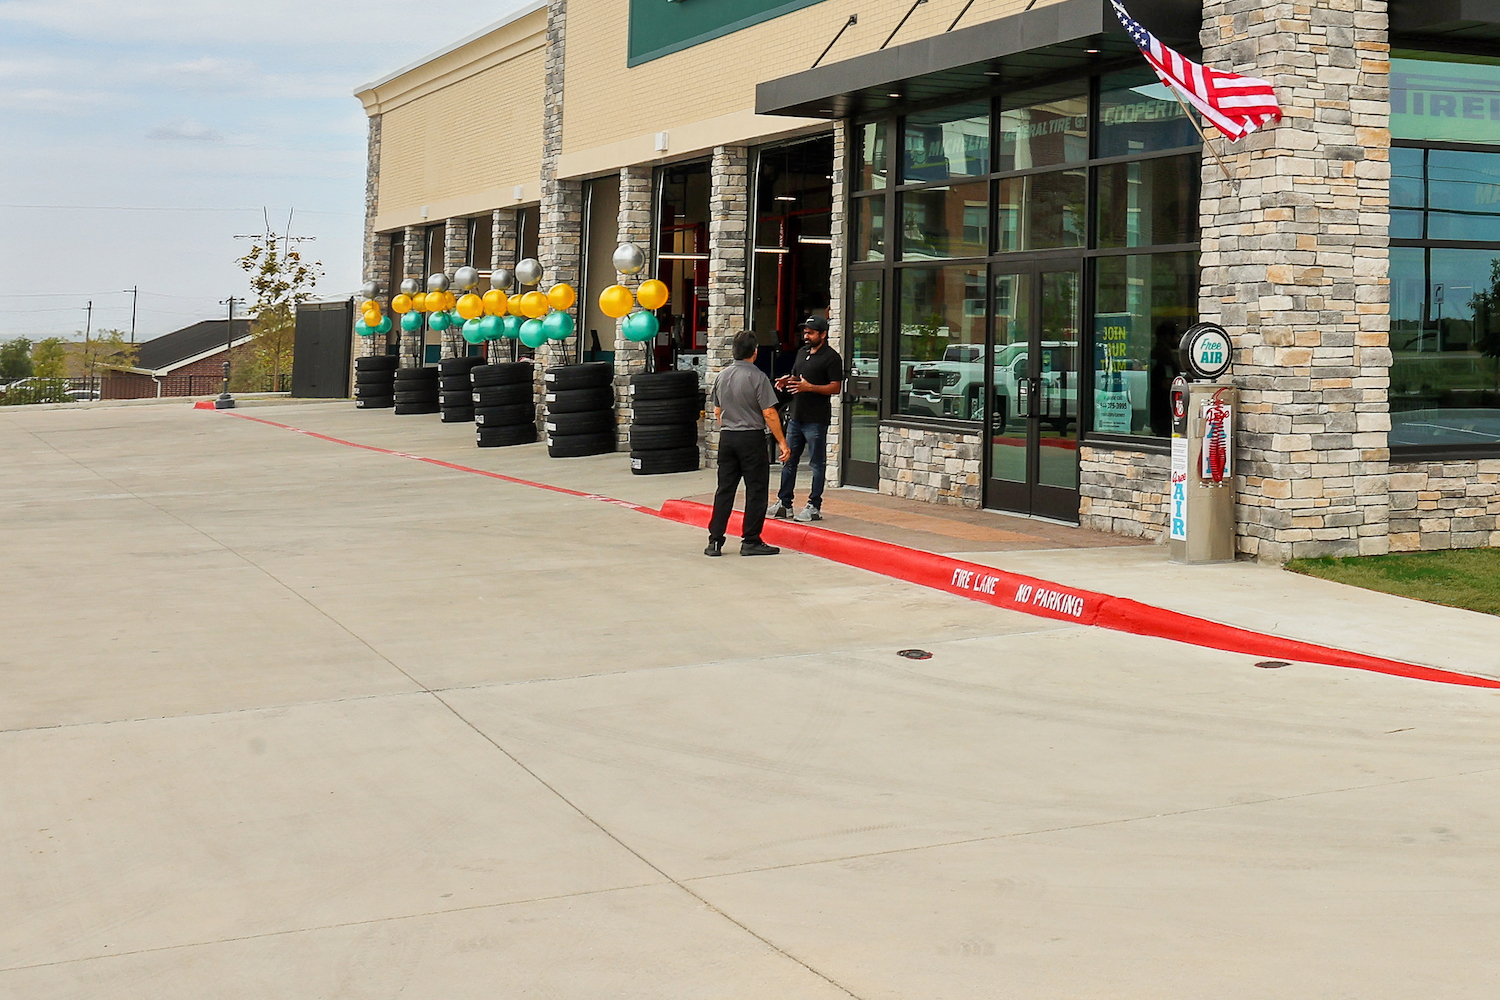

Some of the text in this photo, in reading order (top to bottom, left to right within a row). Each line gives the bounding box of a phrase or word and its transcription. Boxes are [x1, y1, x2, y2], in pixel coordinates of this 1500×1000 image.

[1049, 117, 1072, 134] TIRE
[1103, 326, 1126, 340] JOIN
[1106, 342, 1127, 357] OUR
[1200, 337, 1223, 351] Free
[1200, 351, 1223, 365] AIR
[1100, 359, 1127, 373] TAM
[1172, 484, 1185, 536] AIR
[951, 568, 1084, 617] FIRE LANE NO PARKING
